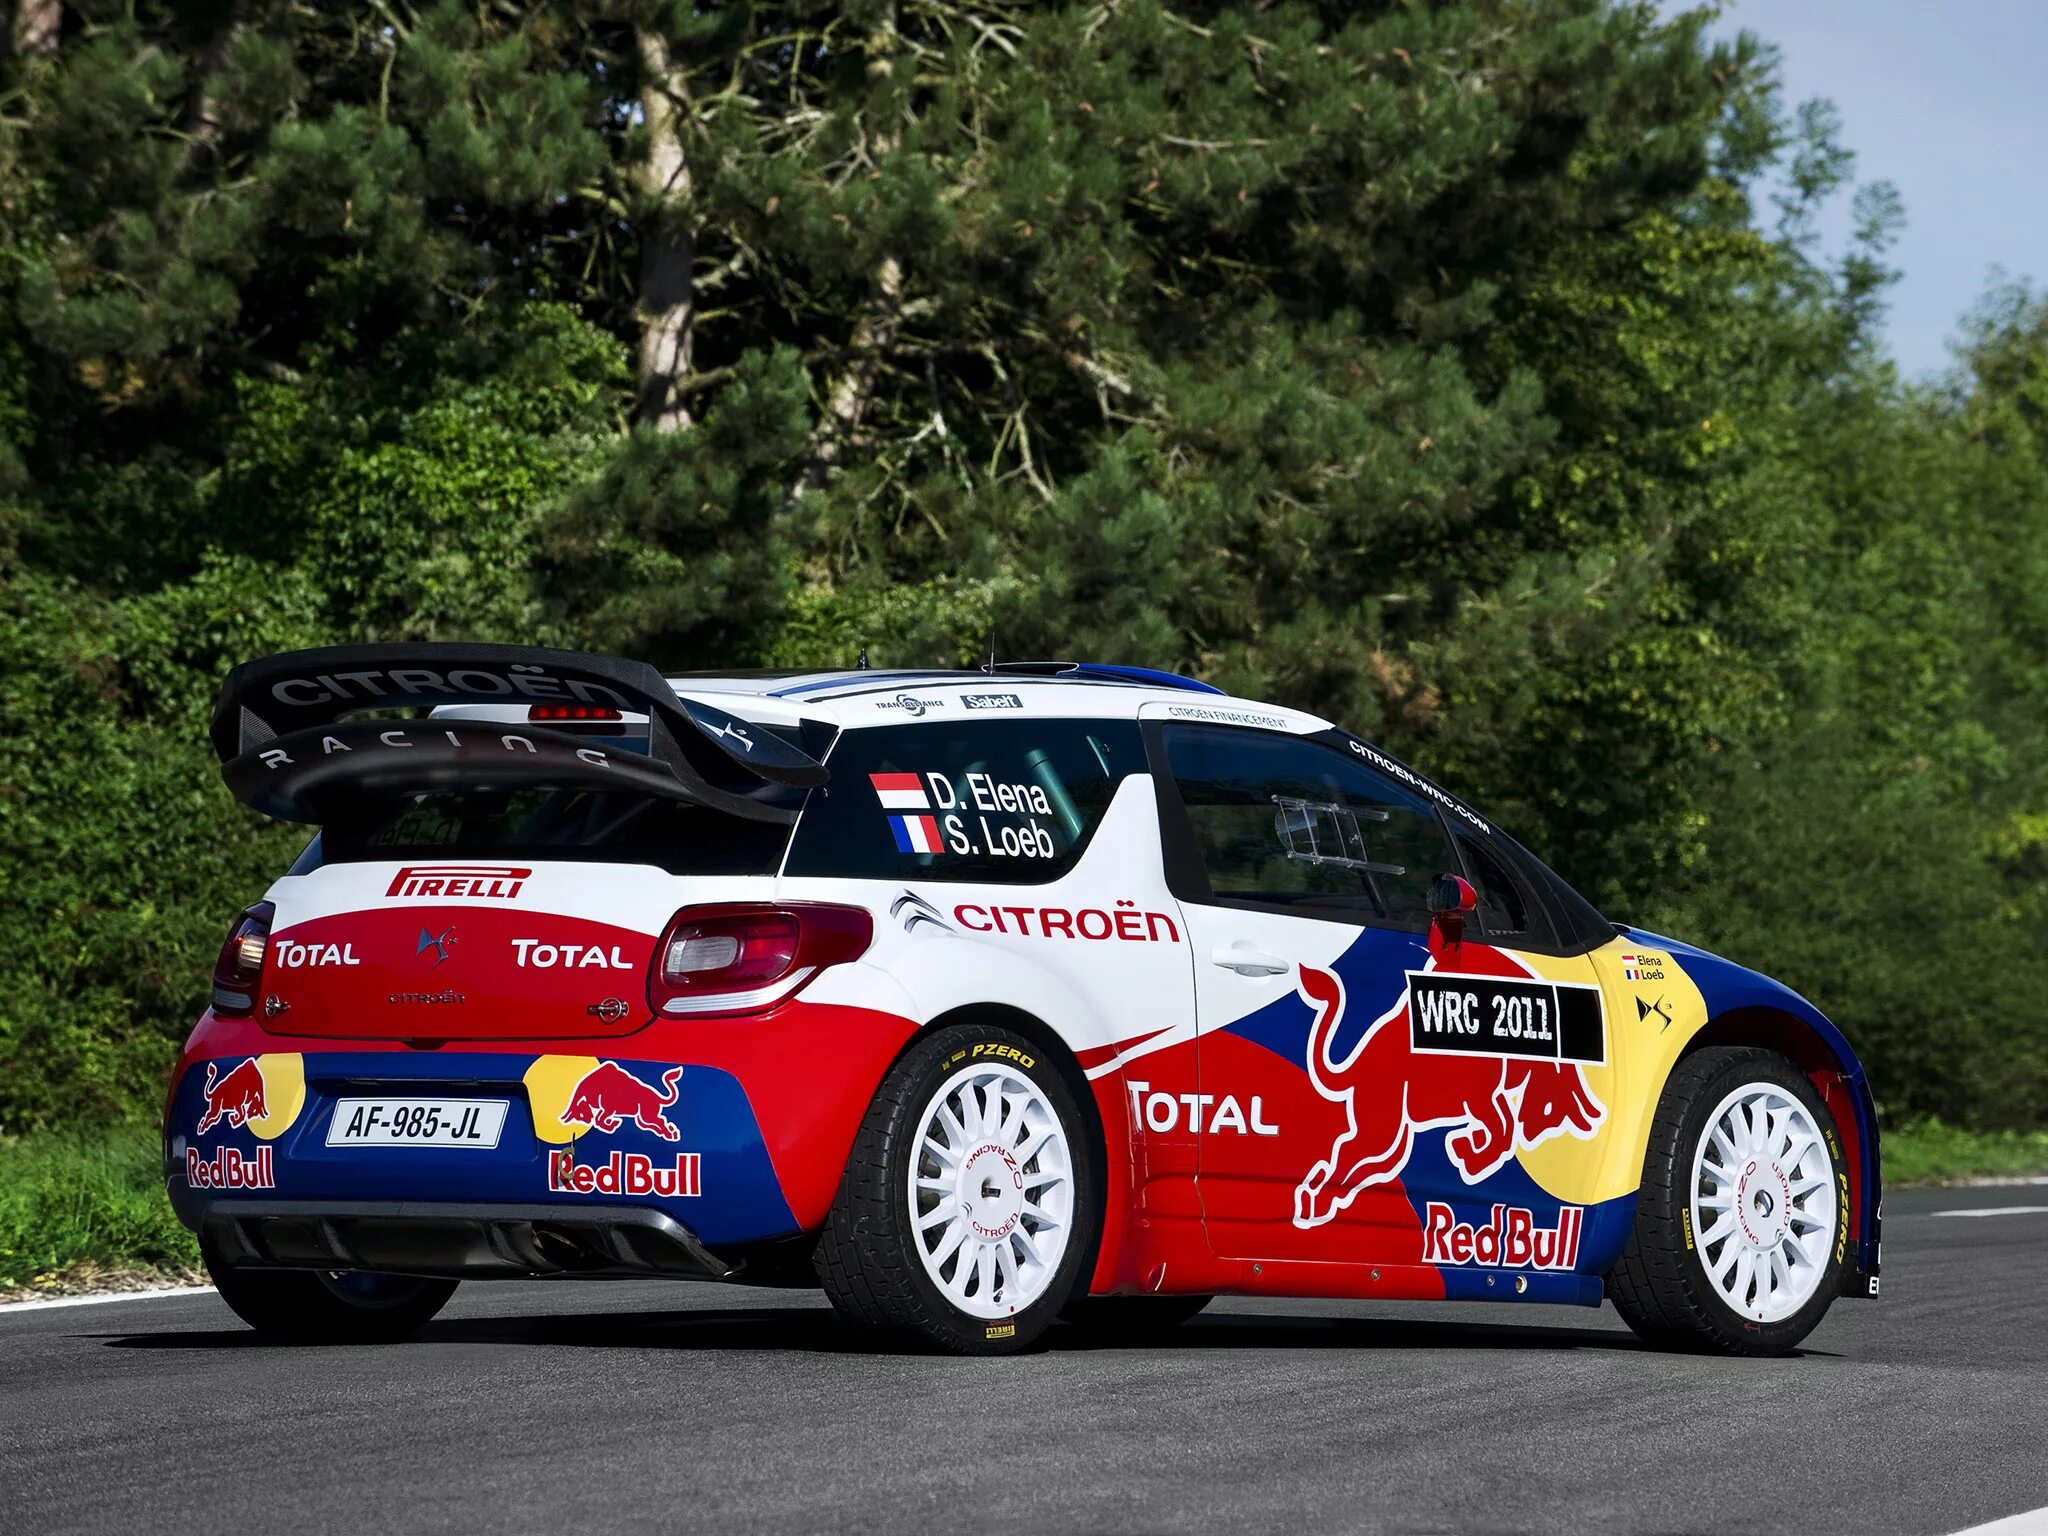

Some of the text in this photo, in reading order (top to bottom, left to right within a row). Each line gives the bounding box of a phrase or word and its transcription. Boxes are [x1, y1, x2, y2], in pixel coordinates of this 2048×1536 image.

[966, 695, 1018, 708] Sabelt
[1214, 711, 1288, 729] FINANCEMENT
[926, 773, 1053, 816] D. Elena
[1349, 740, 1491, 835] CITROEN-WRC.COM
[944, 815, 1055, 859] S. Loeb
[385, 866, 533, 899] PIRELLI
[1637, 954, 1662, 966] Elena
[1641, 969, 1665, 980] Loeb
[1417, 989, 1553, 1041] WRC 2011
[345, 1106, 482, 1139] AF-985-JL
[186, 1145, 276, 1189] Red Bull
[549, 1149, 702, 1198] Red Bull
[966, 1144, 1006, 1170] RACING
[1421, 1201, 1584, 1271] Red Bull
